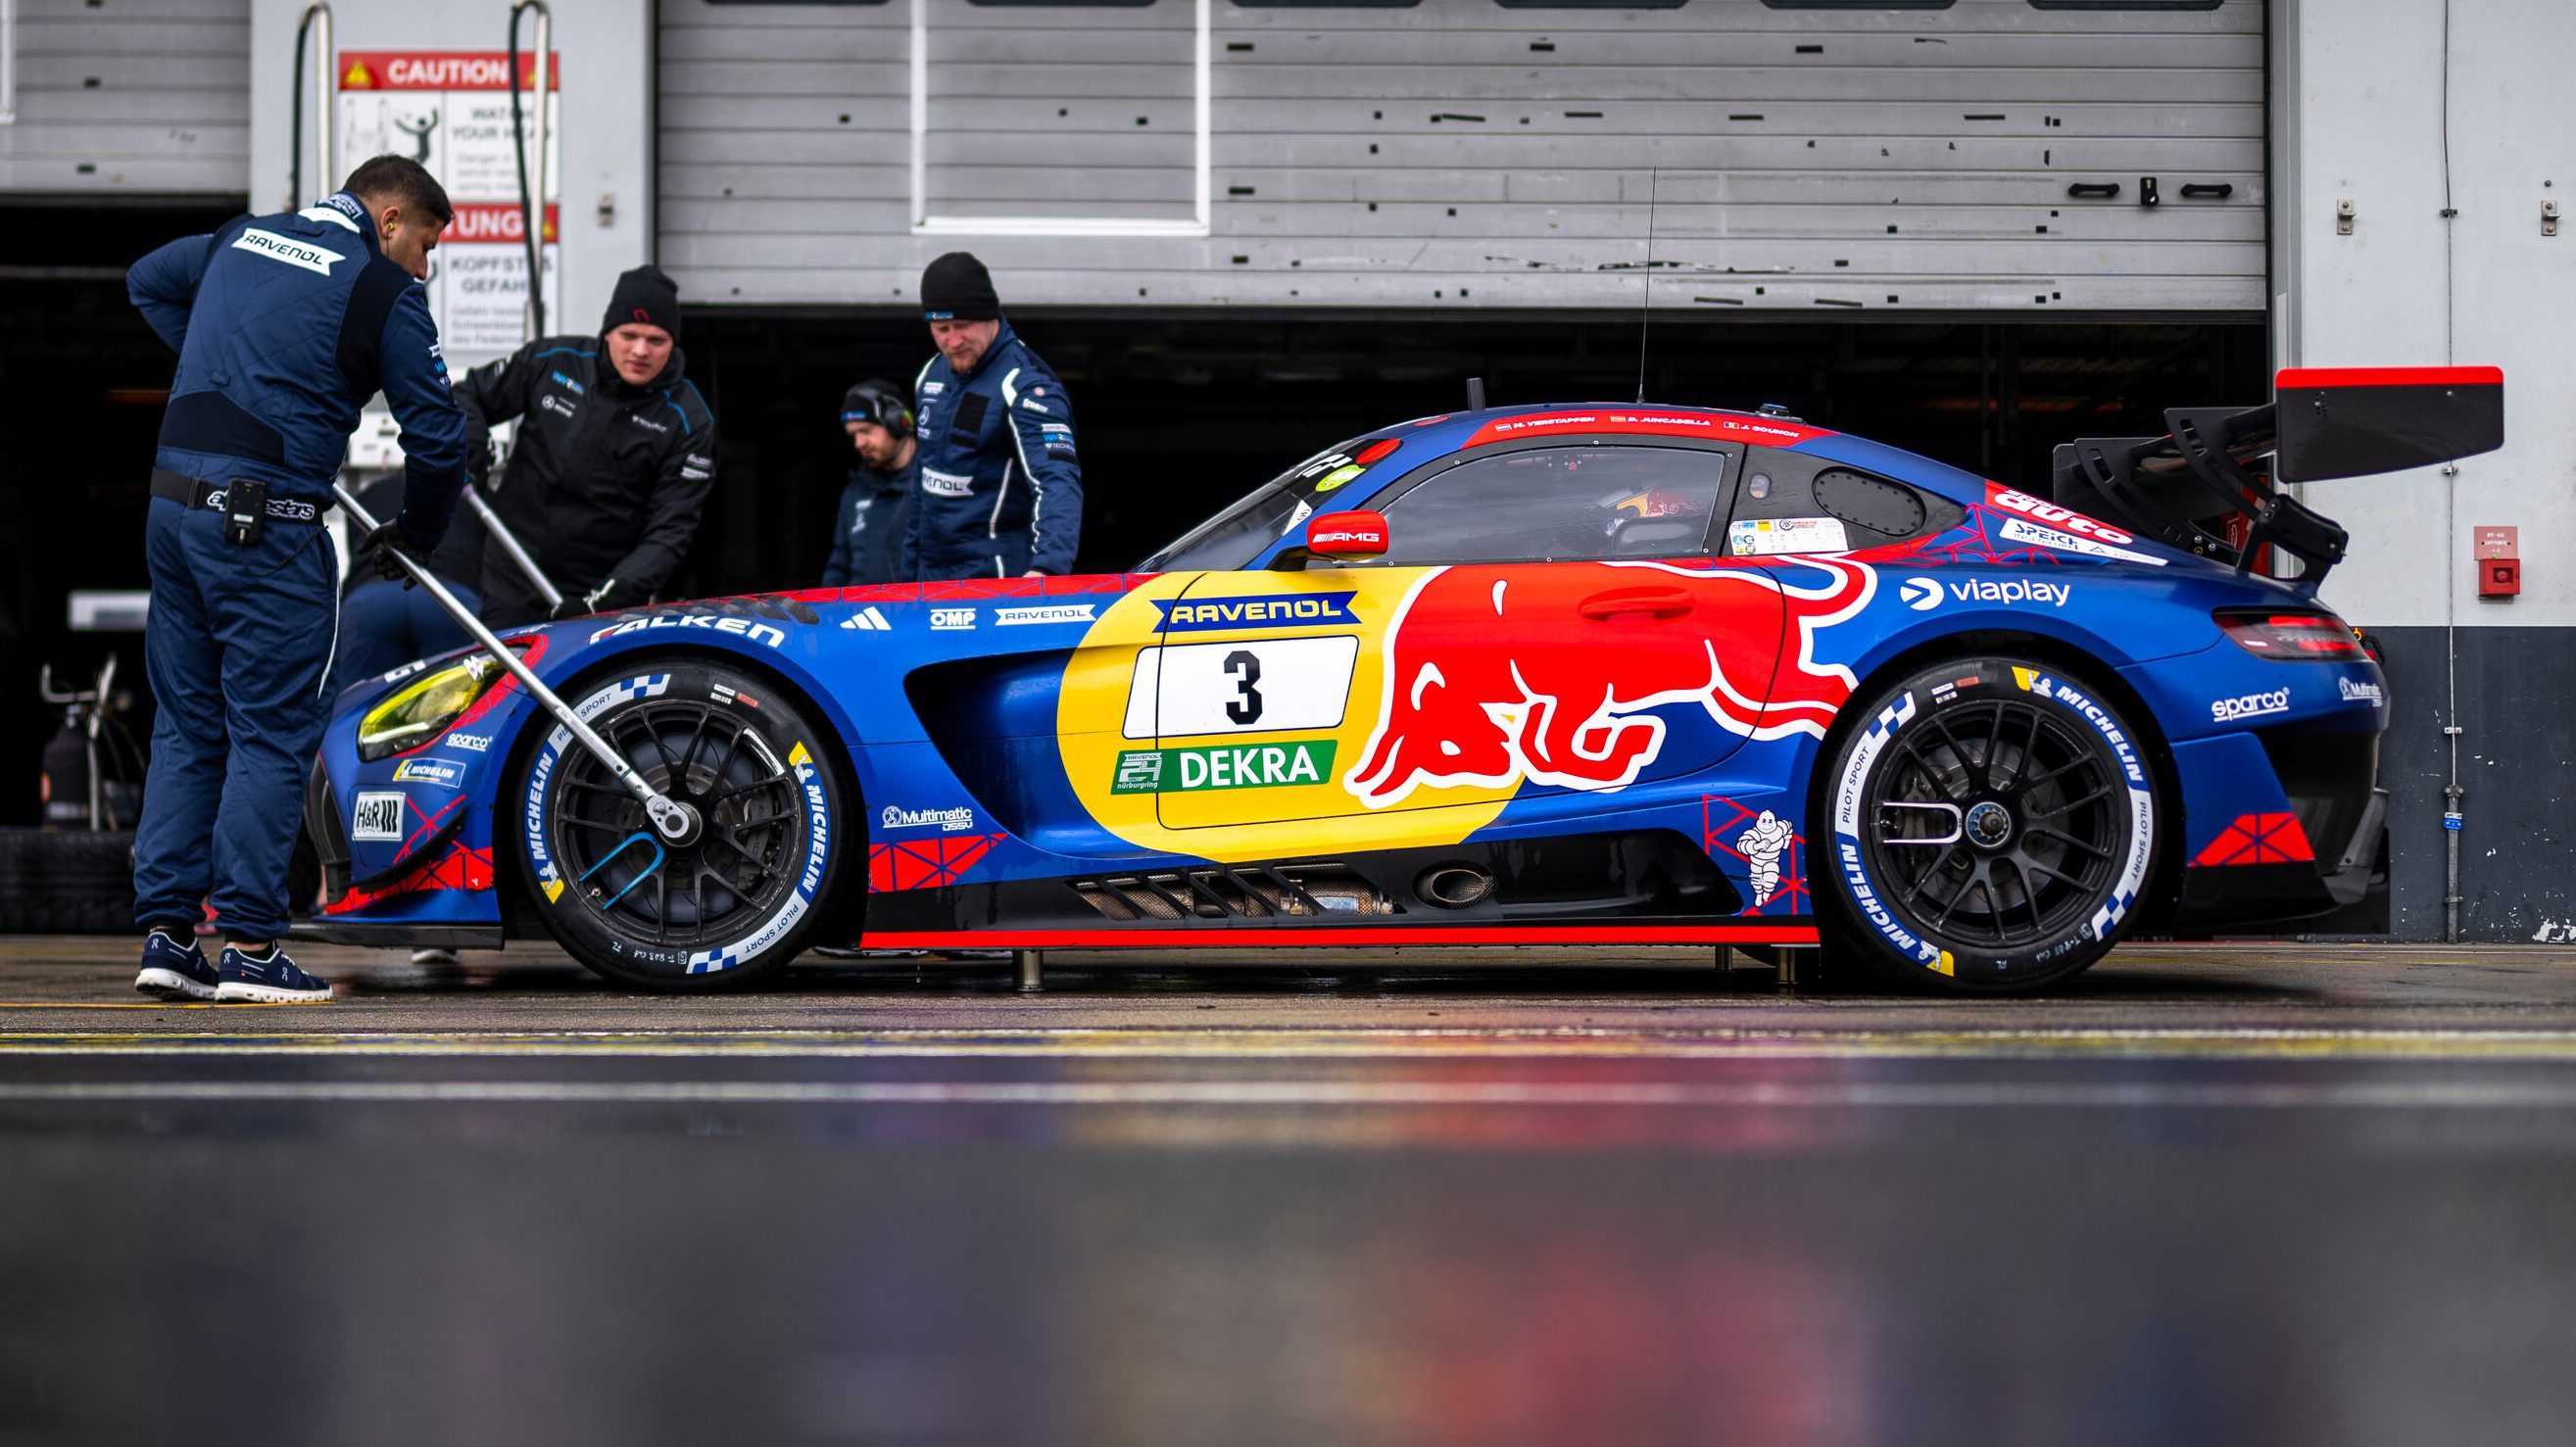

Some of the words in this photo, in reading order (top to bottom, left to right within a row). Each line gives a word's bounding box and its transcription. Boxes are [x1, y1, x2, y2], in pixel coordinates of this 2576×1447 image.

[387, 58, 509, 84] CAUTION
[243, 234, 323, 265] RAVENOL
[462, 278, 528, 294] GEFAH
[1527, 416, 1596, 427] VERSTAPPEN
[1640, 416, 1711, 426] JUNCADELLA
[1752, 425, 1800, 438] GOUNON
[1994, 493, 2133, 545] auto
[1332, 532, 1380, 543] AMG
[1949, 578, 2070, 607] viaplay
[931, 609, 976, 629] OMP
[1005, 608, 1088, 622] RAVENOL
[1170, 599, 1342, 624] RAVENOL
[589, 615, 785, 649] FALKEN
[1223, 650, 1263, 725] 3
[580, 693, 611, 717] SPORT
[2211, 690, 2288, 721] sparco
[446, 733, 488, 751] sparco
[2056, 686, 2144, 782] MICHELIN
[410, 764, 456, 780] MICHELIN
[1180, 745, 1321, 789] DEKRA
[1849, 746, 1871, 787] SPORT
[1117, 781, 1158, 790] nürburgring
[357, 801, 380, 832] H&R
[525, 751, 554, 860] MICHELIN
[902, 806, 972, 824] Multimatic
[1842, 790, 1857, 824] PILOT
[2139, 801, 2149, 836] PILOT
[802, 785, 827, 892] MICHELIN
[942, 821, 973, 831] DSSV
[2131, 838, 2147, 881] SPORT
[1841, 844, 1917, 951] MICHELIN
[777, 903, 800, 932] PILOT
[745, 930, 776, 954] SPORT
